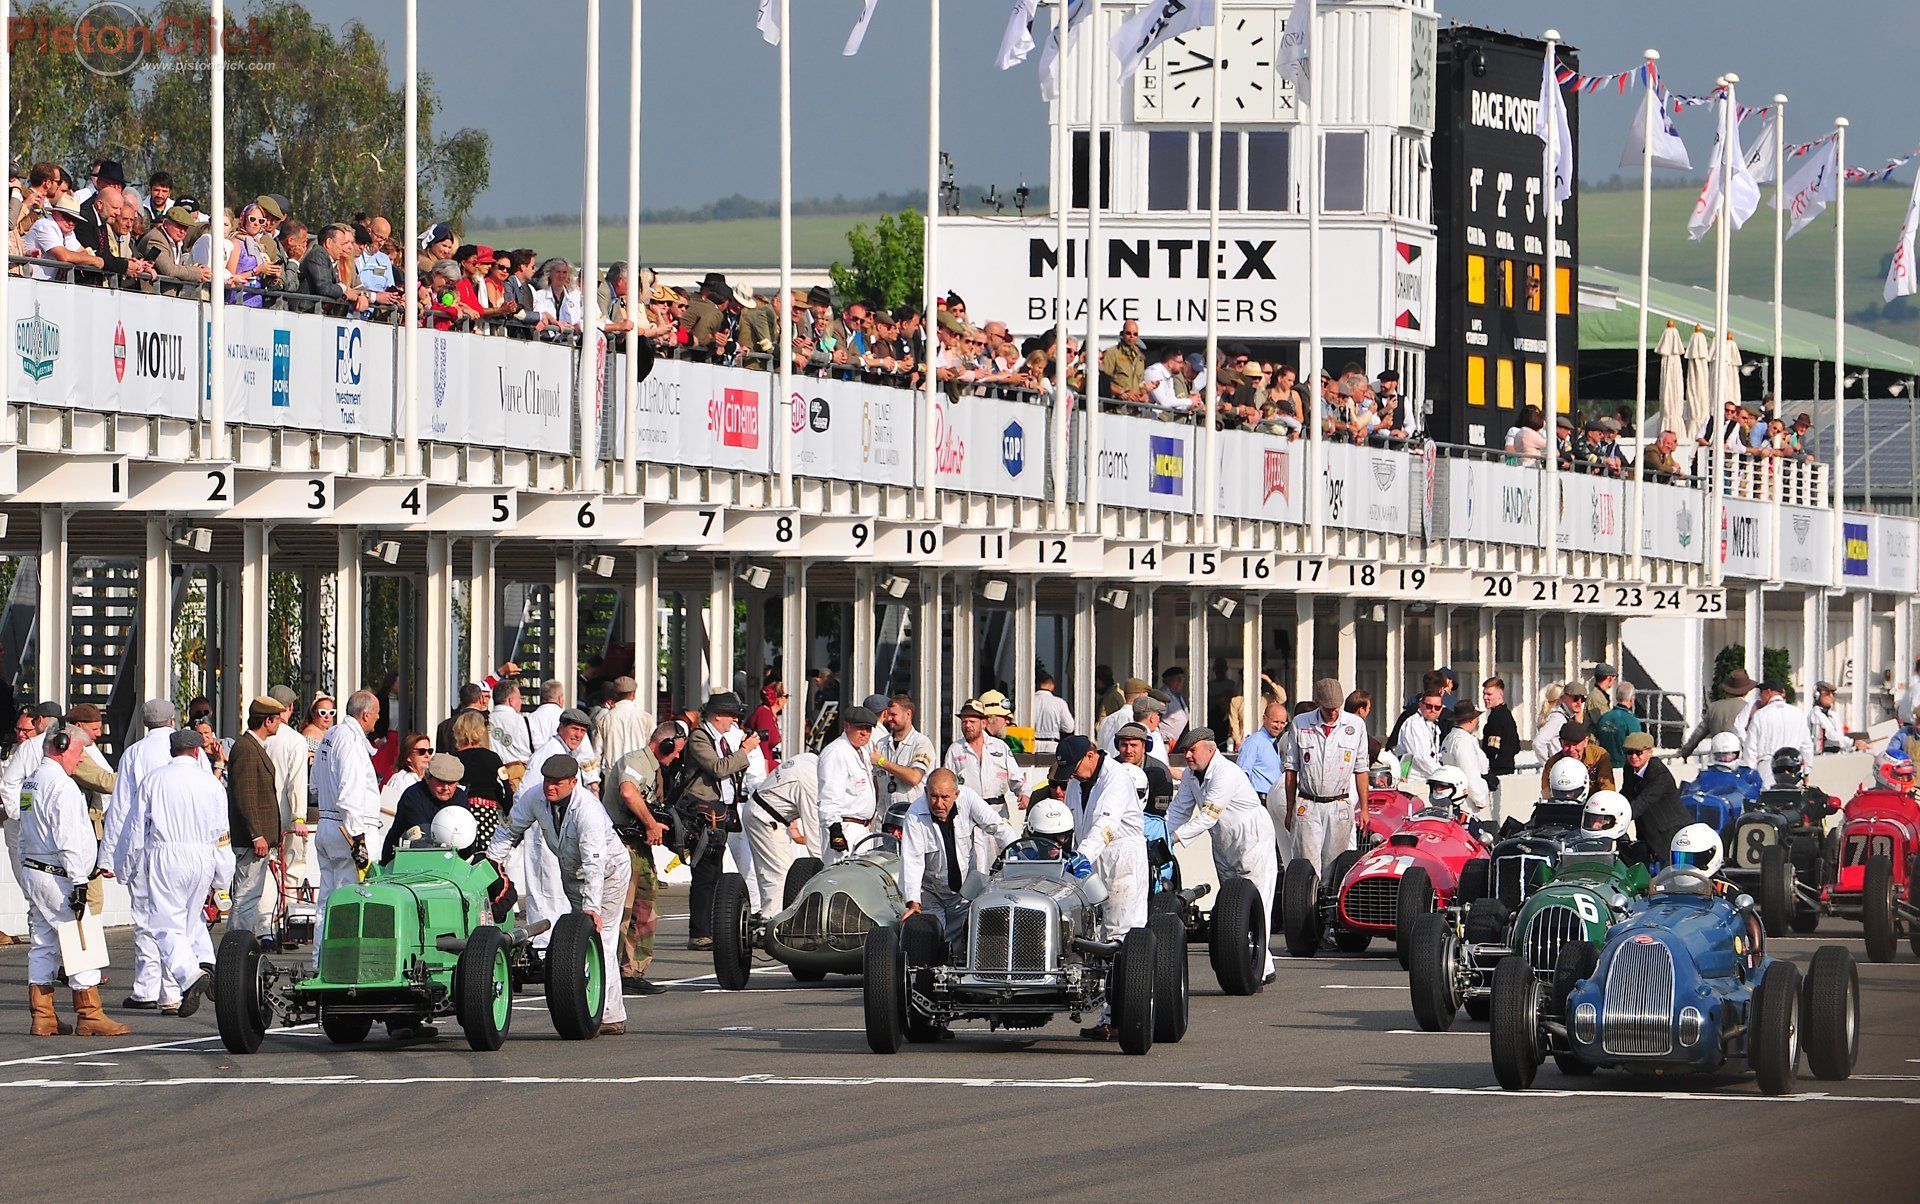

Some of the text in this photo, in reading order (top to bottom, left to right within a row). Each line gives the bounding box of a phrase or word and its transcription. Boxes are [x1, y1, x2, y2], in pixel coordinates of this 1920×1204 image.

[1471, 89, 1504, 130] RACE
[1029, 238, 1278, 280] MNTEX
[1157, 298, 1278, 322] LINERS
[136, 330, 187, 381] MOTUL
[336, 325, 362, 386] F&C
[524, 368, 561, 427] Clicquot
[340, 407, 356, 425] Trust
[707, 387, 723, 442] sky
[725, 394, 758, 435] cinema
[112, 463, 120, 493] 1
[207, 471, 227, 501] 2
[307, 479, 326, 509] 3
[400, 487, 421, 515] 4
[492, 494, 509, 523] 5
[577, 501, 596, 529] 6
[698, 510, 717, 537] 7
[776, 516, 793, 543] 8
[852, 523, 869, 549] 9
[906, 529, 937, 555] 10
[980, 535, 1003, 559] 11
[1039, 540, 1068, 564] 12
[1128, 547, 1156, 571] 14
[1189, 553, 1216, 576] 15
[1242, 556, 1270, 580] 16
[1297, 559, 1322, 582] 17
[1350, 563, 1375, 586] 18
[1400, 569, 1426, 590] 19
[1483, 576, 1513, 597] 20
[1532, 581, 1557, 601] 21
[1572, 584, 1600, 604] 22
[1615, 587, 1643, 607] 23
[1653, 590, 1681, 610] 24
[1696, 593, 1722, 613] 25
[1746, 828, 1770, 865] 8
[1359, 855, 1415, 877] 21
[1573, 893, 1599, 924] 6
